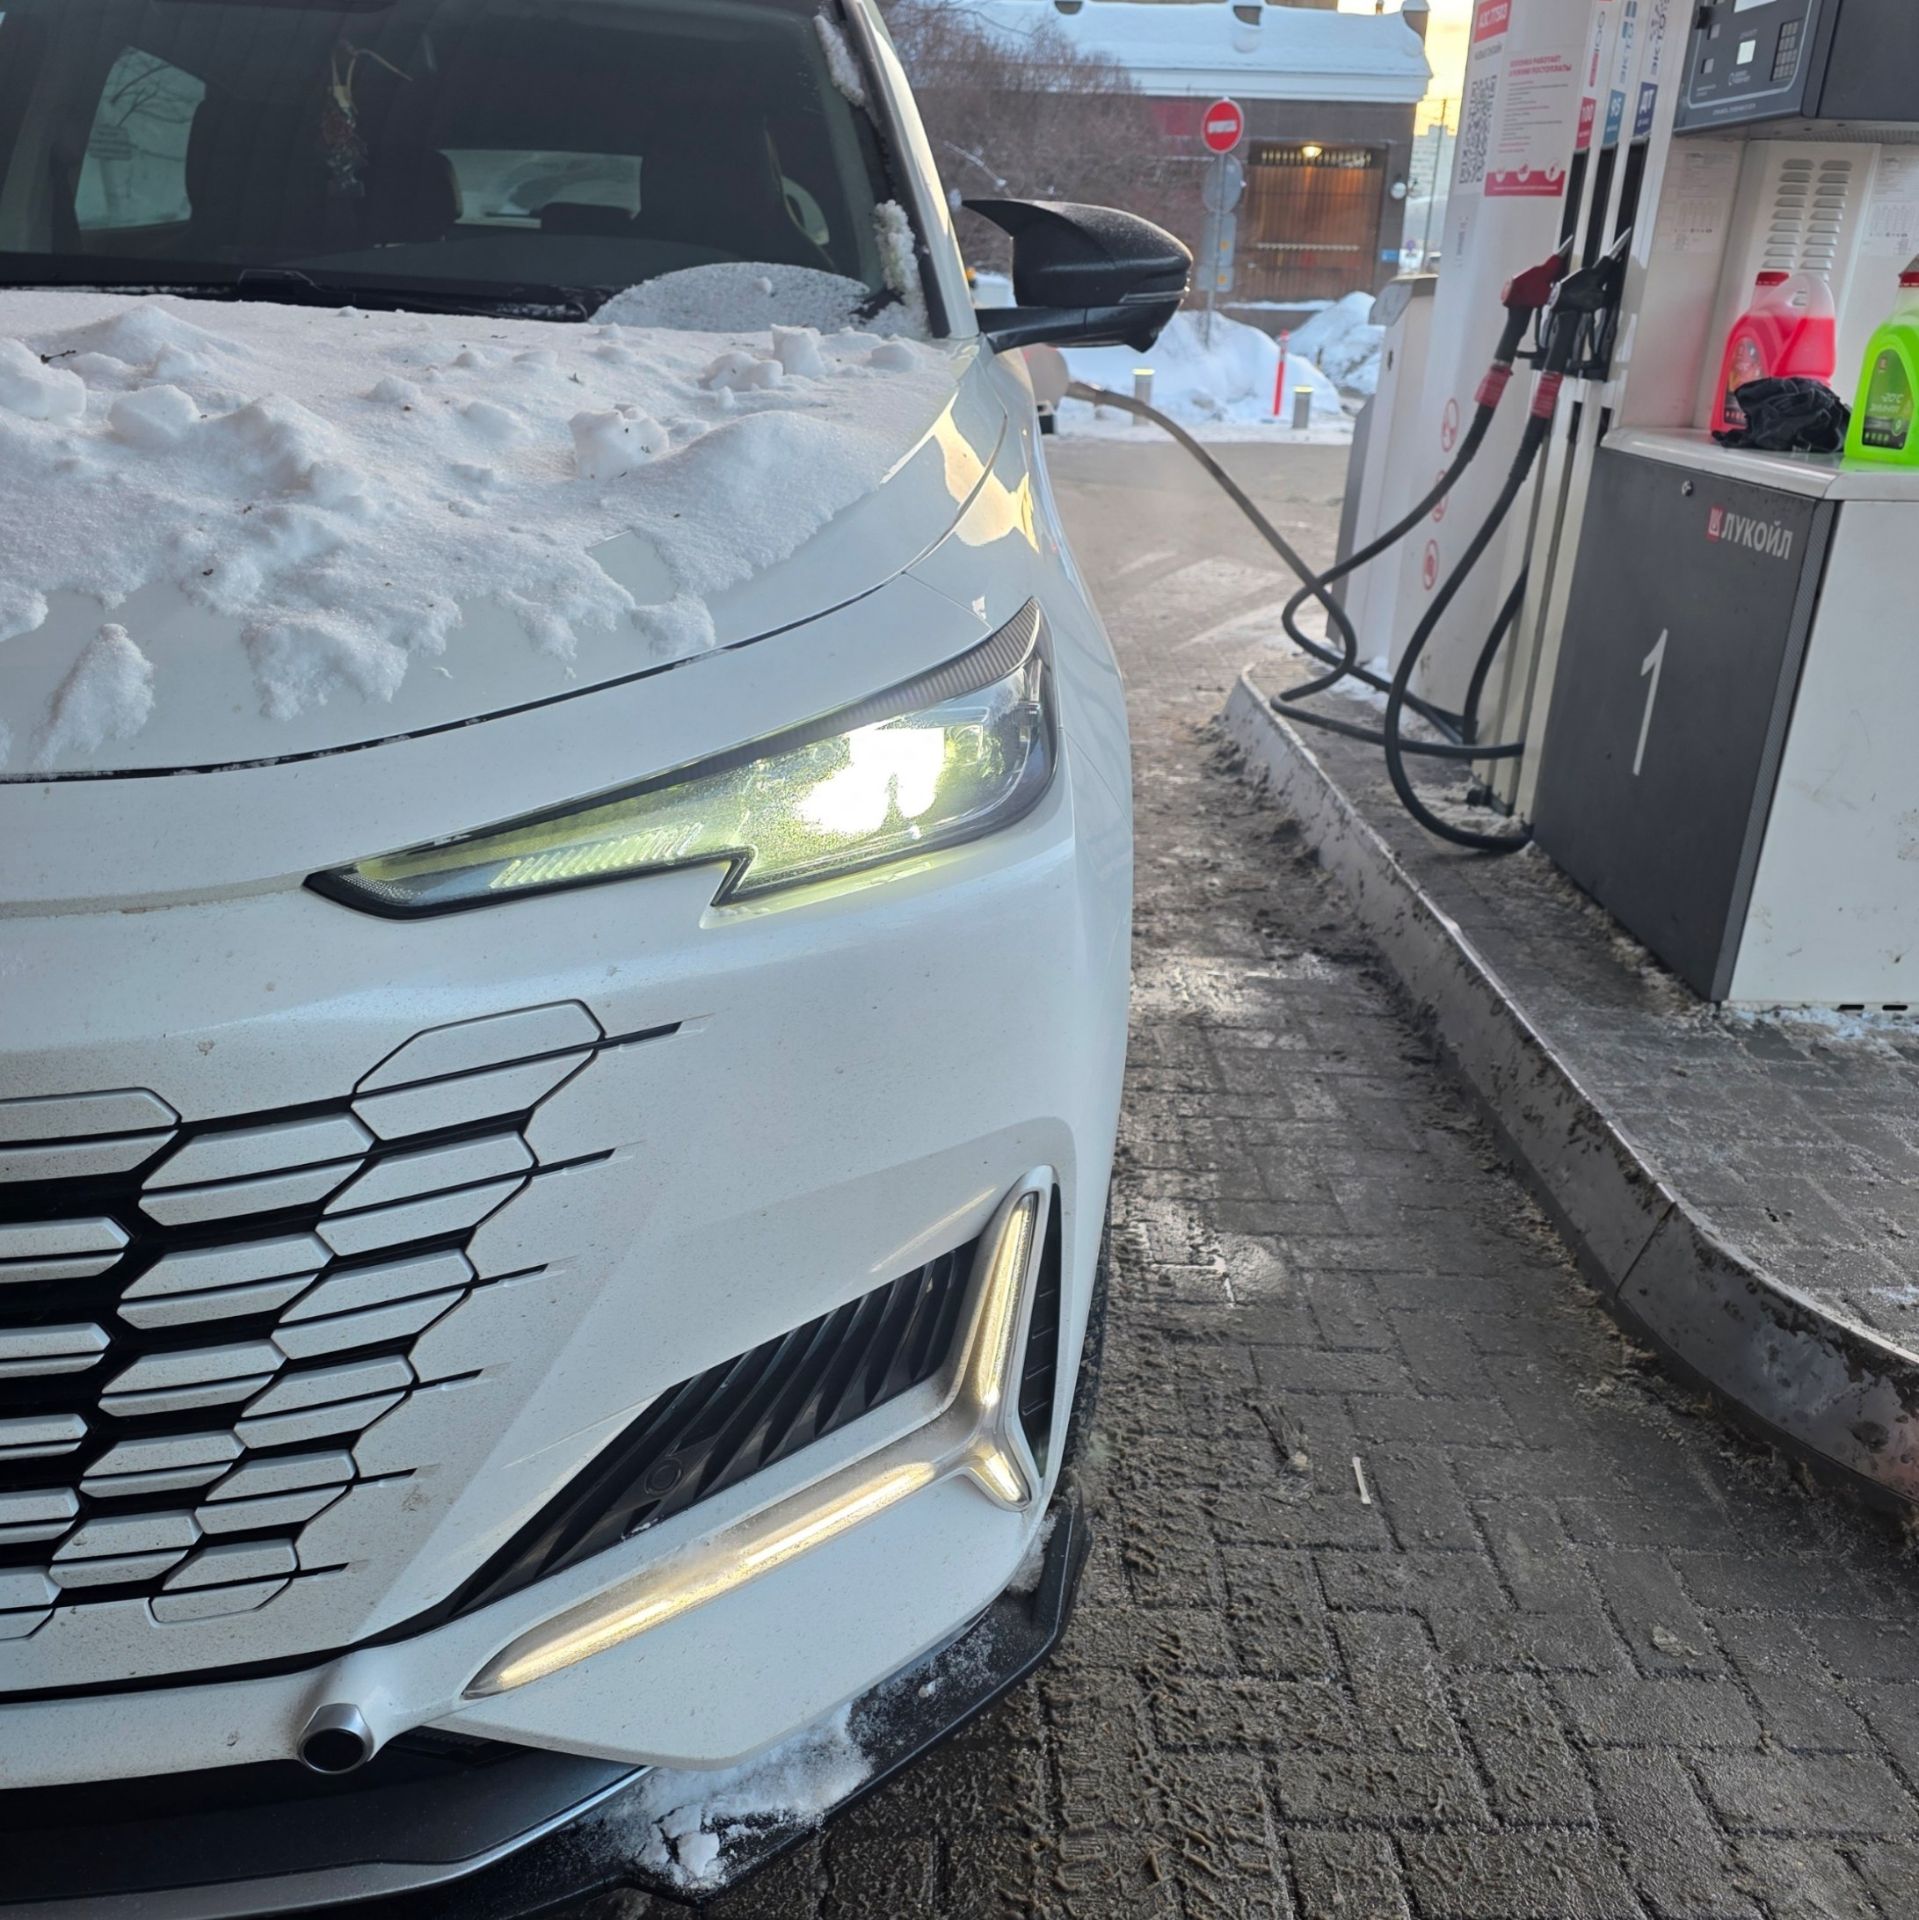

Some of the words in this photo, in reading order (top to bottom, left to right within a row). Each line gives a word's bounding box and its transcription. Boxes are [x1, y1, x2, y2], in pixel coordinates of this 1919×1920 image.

[1582, 104, 1594, 123] 100
[1611, 98, 1622, 118] 95
[1640, 89, 1654, 115] ДТ
[1721, 511, 1794, 560] ЛУКОЙЛ
[1633, 628, 1668, 776] 1
